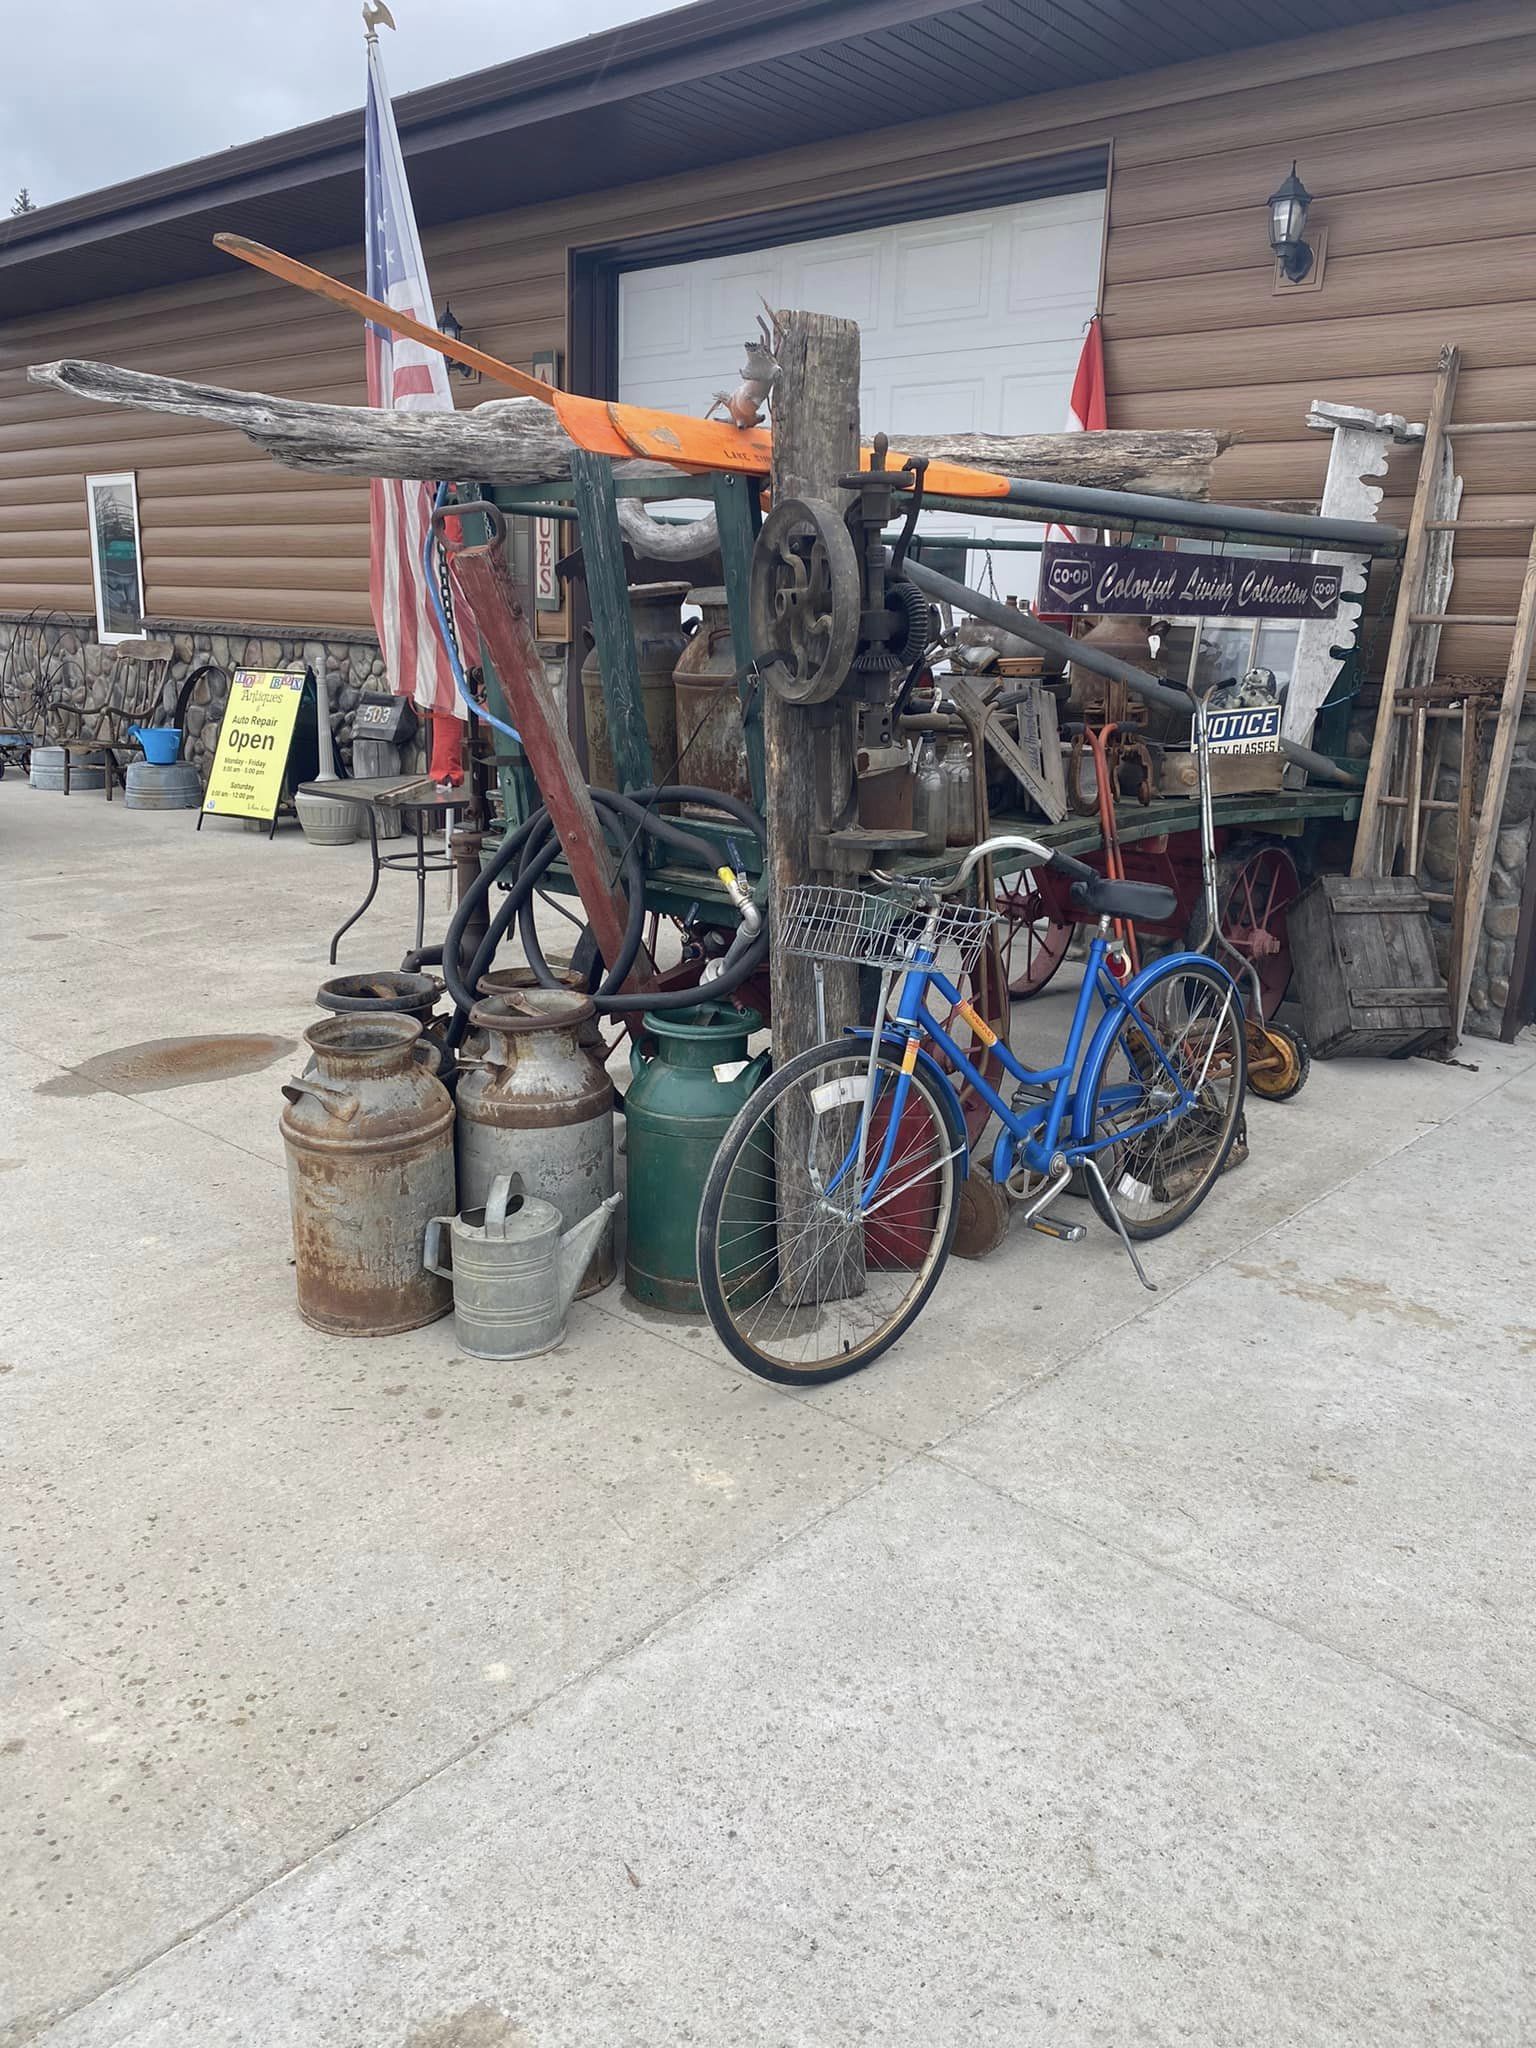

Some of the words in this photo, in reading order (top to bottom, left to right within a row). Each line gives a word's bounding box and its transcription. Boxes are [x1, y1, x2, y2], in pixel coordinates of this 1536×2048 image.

[1096, 562, 1176, 610] Colorful
[1179, 566, 1234, 611] Living
[1238, 570, 1308, 607] Collection
[241, 690, 284, 707] Antiques
[232, 715, 249, 724] Auto
[251, 715, 278, 728] Repair
[363, 705, 391, 723] 503
[229, 729, 274, 752] Open
[224, 757, 244, 766] Monday
[248, 759, 266, 769] Friday
[230, 782, 255, 792] Saturday
